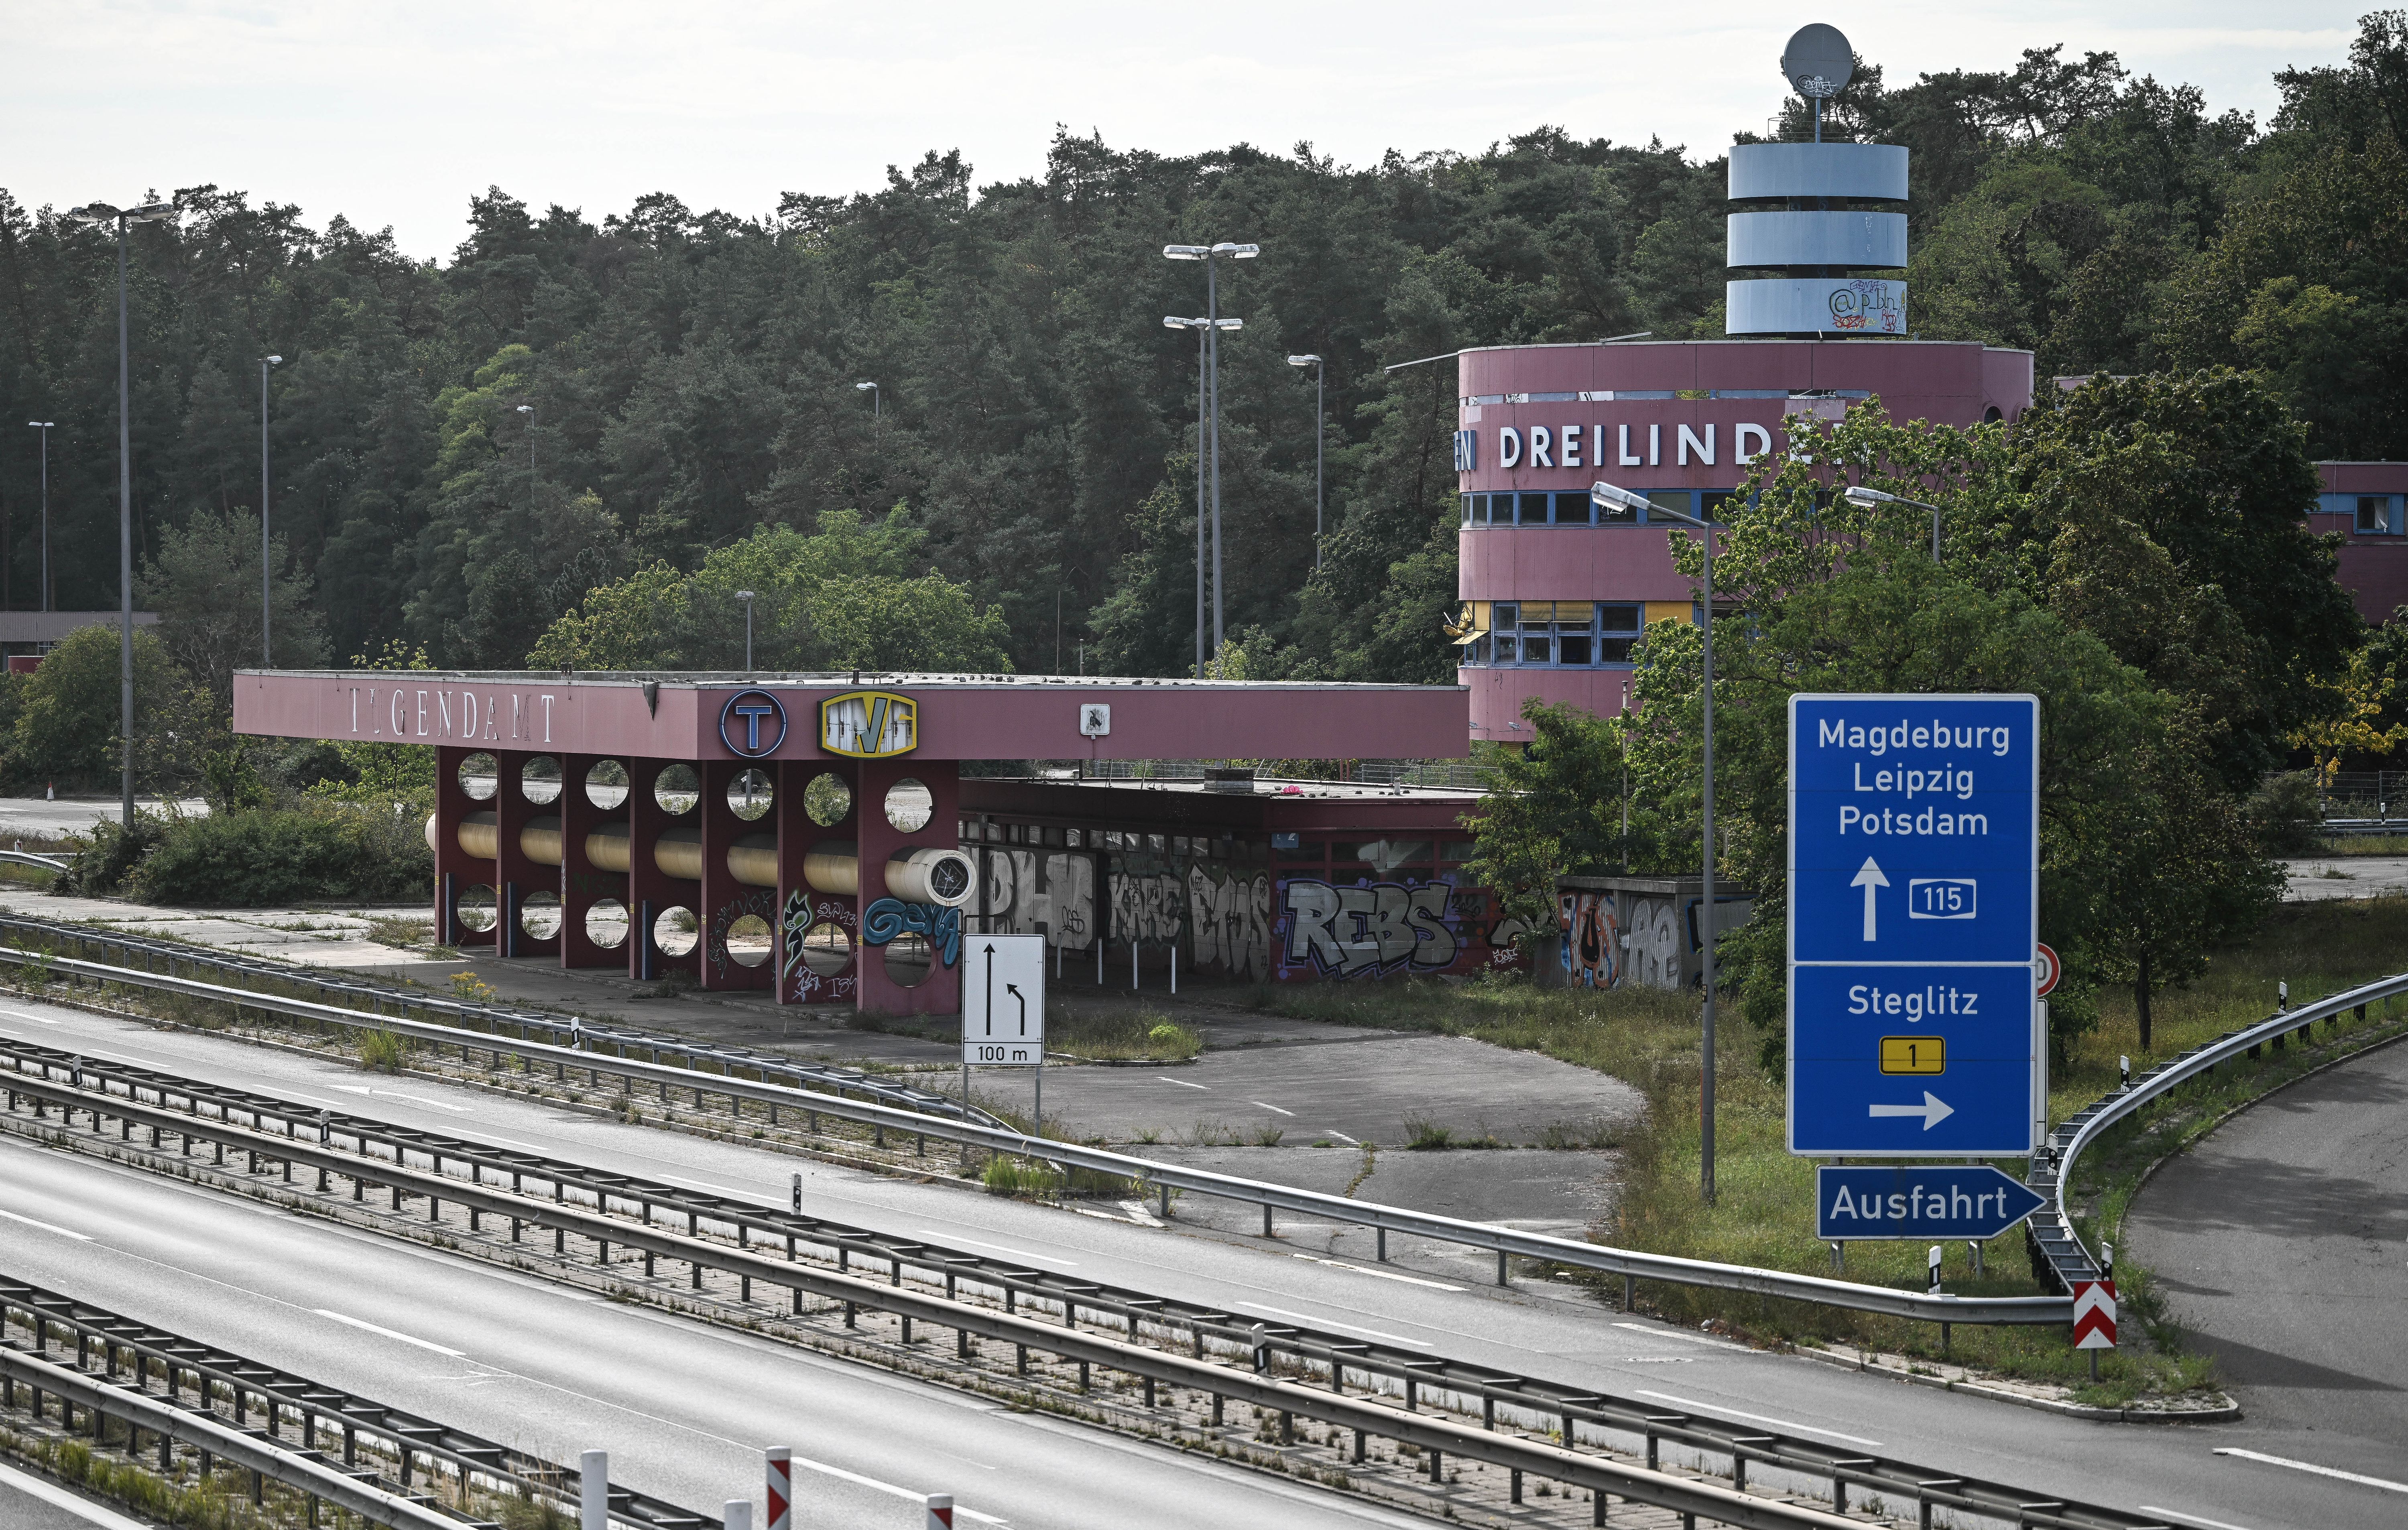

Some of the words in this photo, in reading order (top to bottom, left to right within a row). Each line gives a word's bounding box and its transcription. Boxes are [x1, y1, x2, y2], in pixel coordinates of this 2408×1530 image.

[1819, 719, 2009, 756] Magdeburg
[1854, 763, 1973, 799] Leipzig
[1839, 807, 1988, 835] Potsdam
[1924, 887, 1962, 910] 115
[1848, 985, 1978, 1022] Steglitz
[978, 1046, 1005, 1061] 100
[1013, 1050, 1027, 1061] m
[1908, 1044, 1916, 1067] 1
[1829, 1185, 2007, 1219] Ausfahrt
